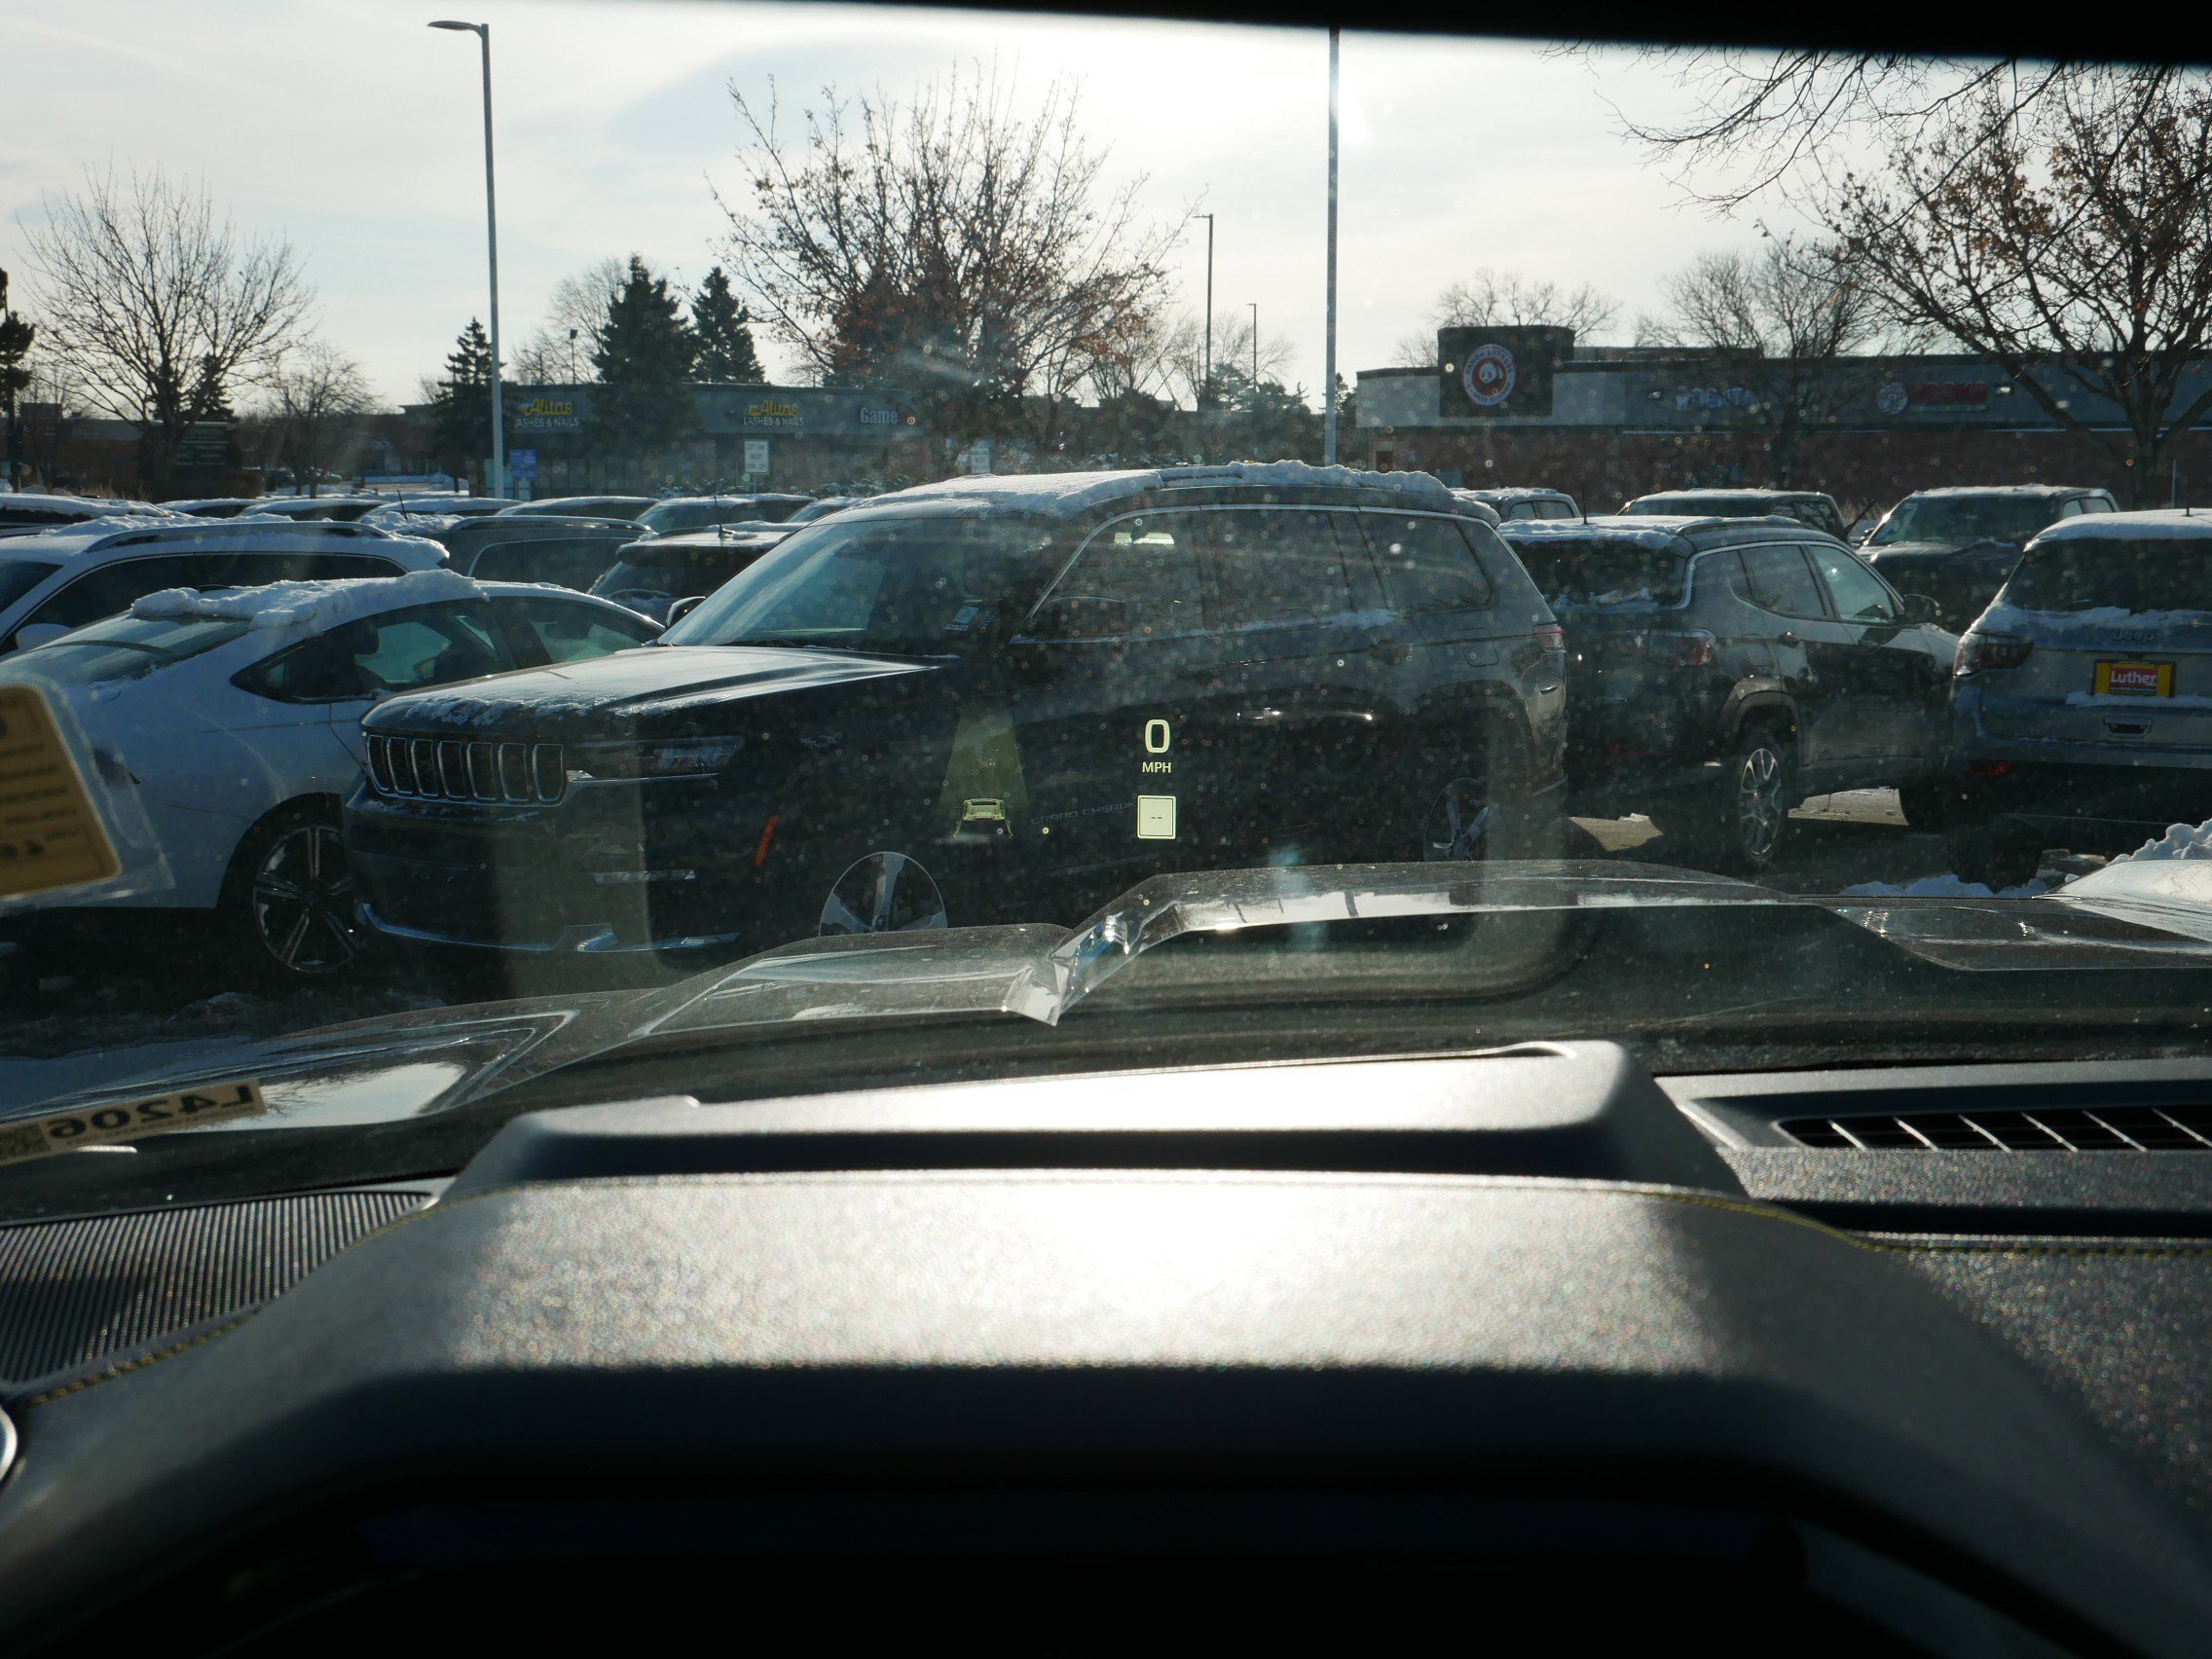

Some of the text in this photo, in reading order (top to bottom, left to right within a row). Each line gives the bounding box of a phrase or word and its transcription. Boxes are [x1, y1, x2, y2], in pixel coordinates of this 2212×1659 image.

[554, 418, 580, 426] NAILS
[743, 417, 773, 426] LASHES
[782, 417, 804, 426] NAILS
[2111, 670, 2157, 684] Luther
[1144, 719, 1171, 754] 0
[1141, 761, 1172, 773] MPH
[1030, 799, 1137, 825] GRAND CHEROK
